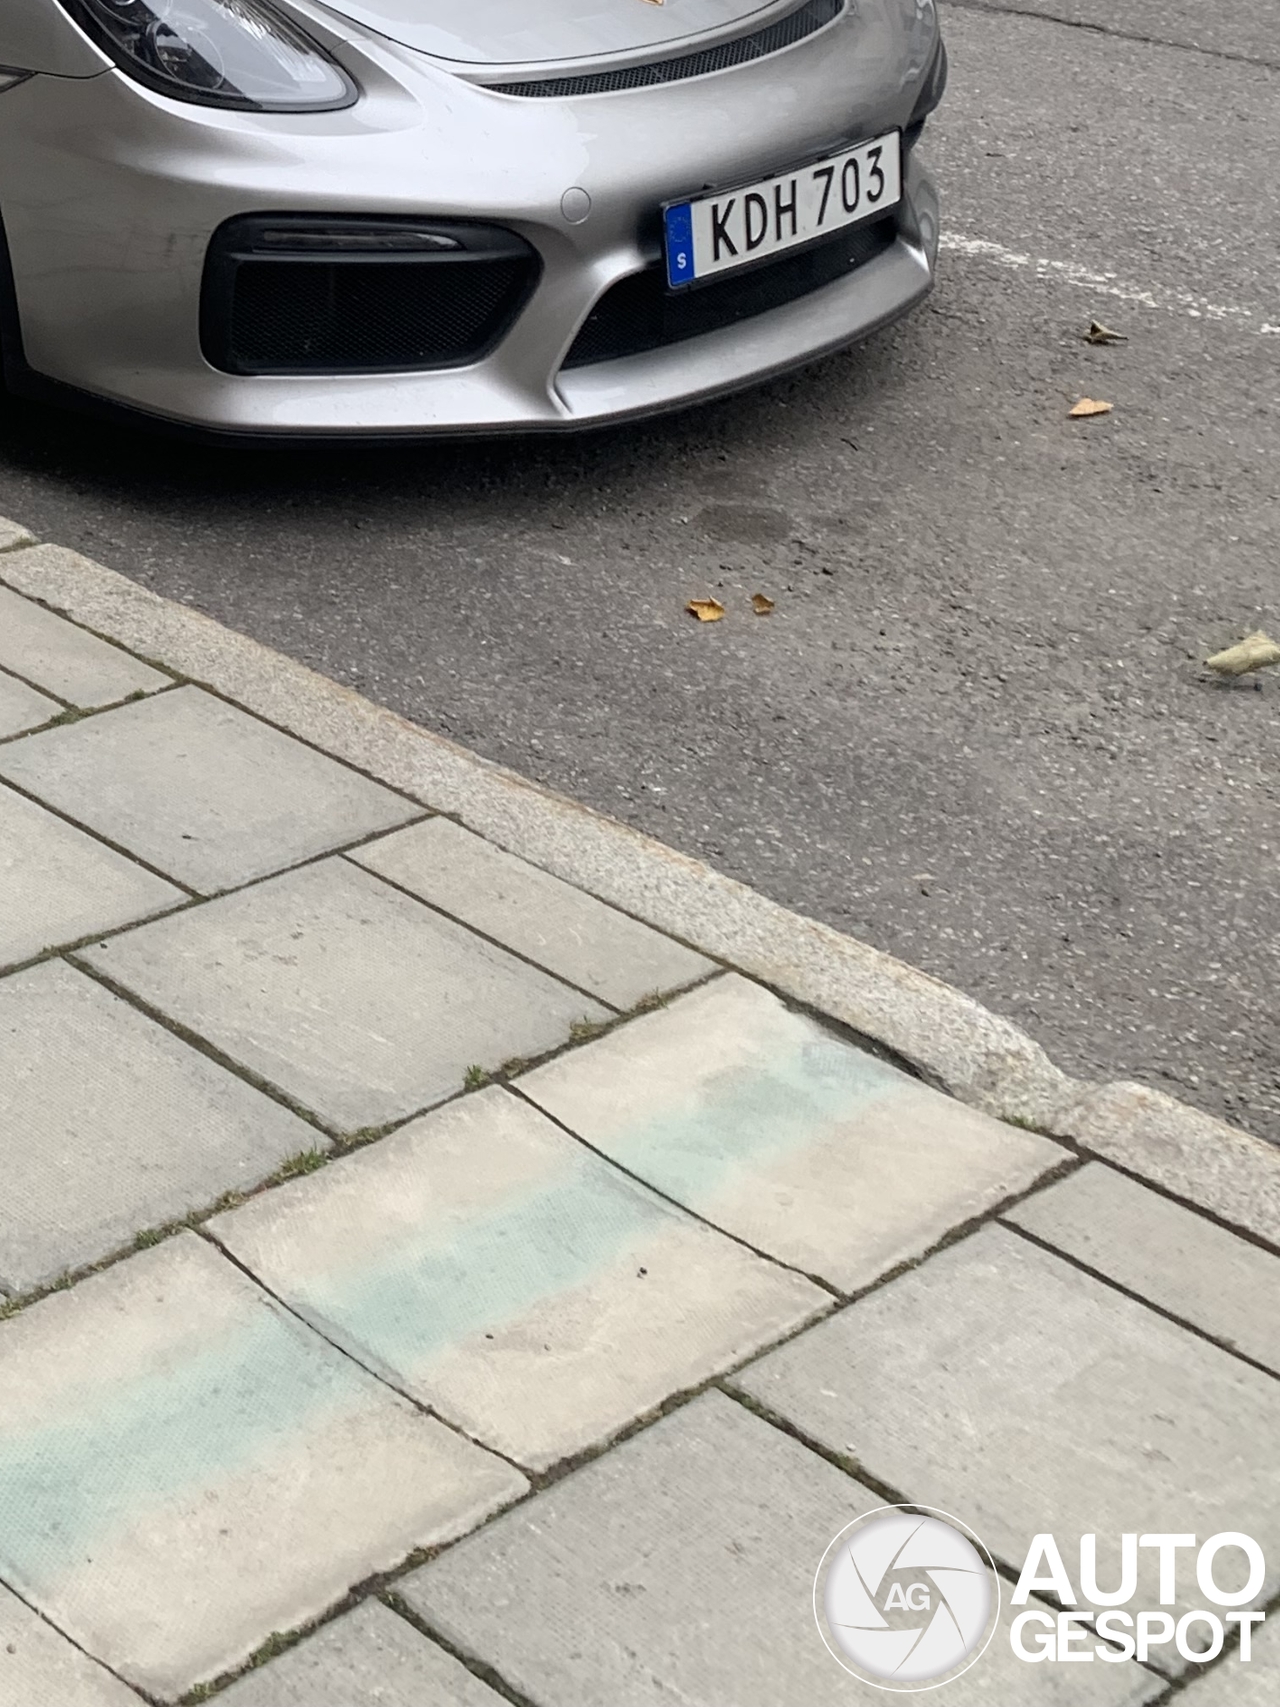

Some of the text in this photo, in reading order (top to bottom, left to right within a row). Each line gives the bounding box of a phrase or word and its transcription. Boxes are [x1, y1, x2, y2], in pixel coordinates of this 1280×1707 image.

[711, 146, 886, 261] KDH 703
[677, 252, 687, 269] S
